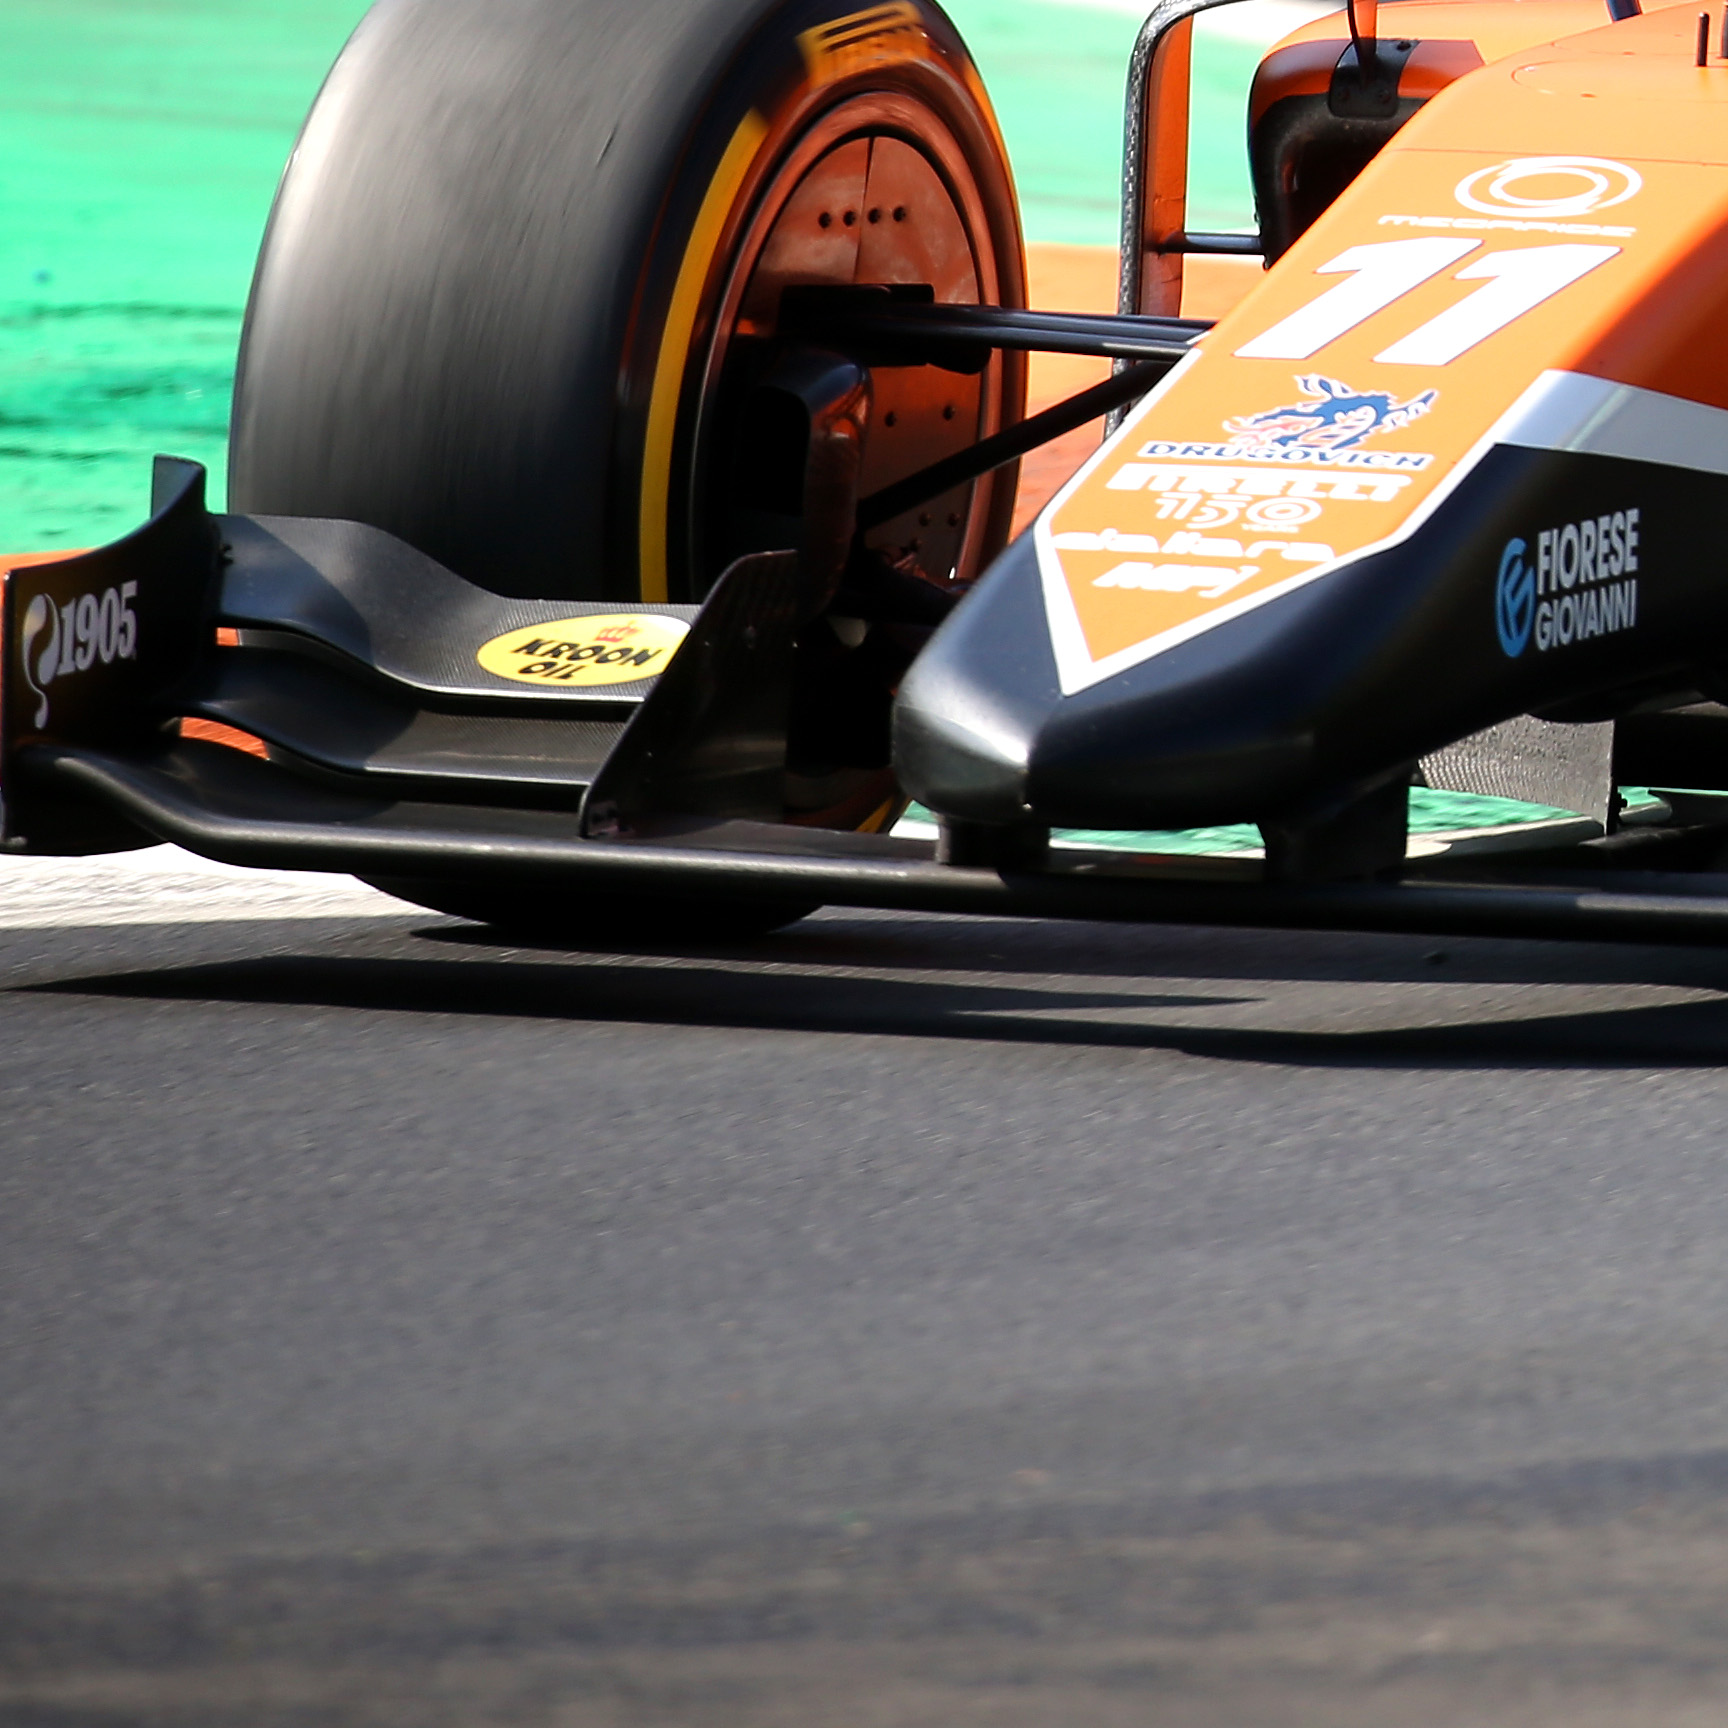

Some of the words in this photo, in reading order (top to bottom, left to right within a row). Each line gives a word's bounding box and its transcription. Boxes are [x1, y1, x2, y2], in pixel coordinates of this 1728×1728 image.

[1231, 235, 1624, 366] 11
[1144, 441, 1433, 470] DRUGOVICH
[1537, 508, 1640, 597] FIORESE
[55, 579, 138, 676] 1905
[1535, 578, 1637, 652] GIOVANNI
[512, 638, 663, 667] KROON
[517, 661, 588, 681] OIL
